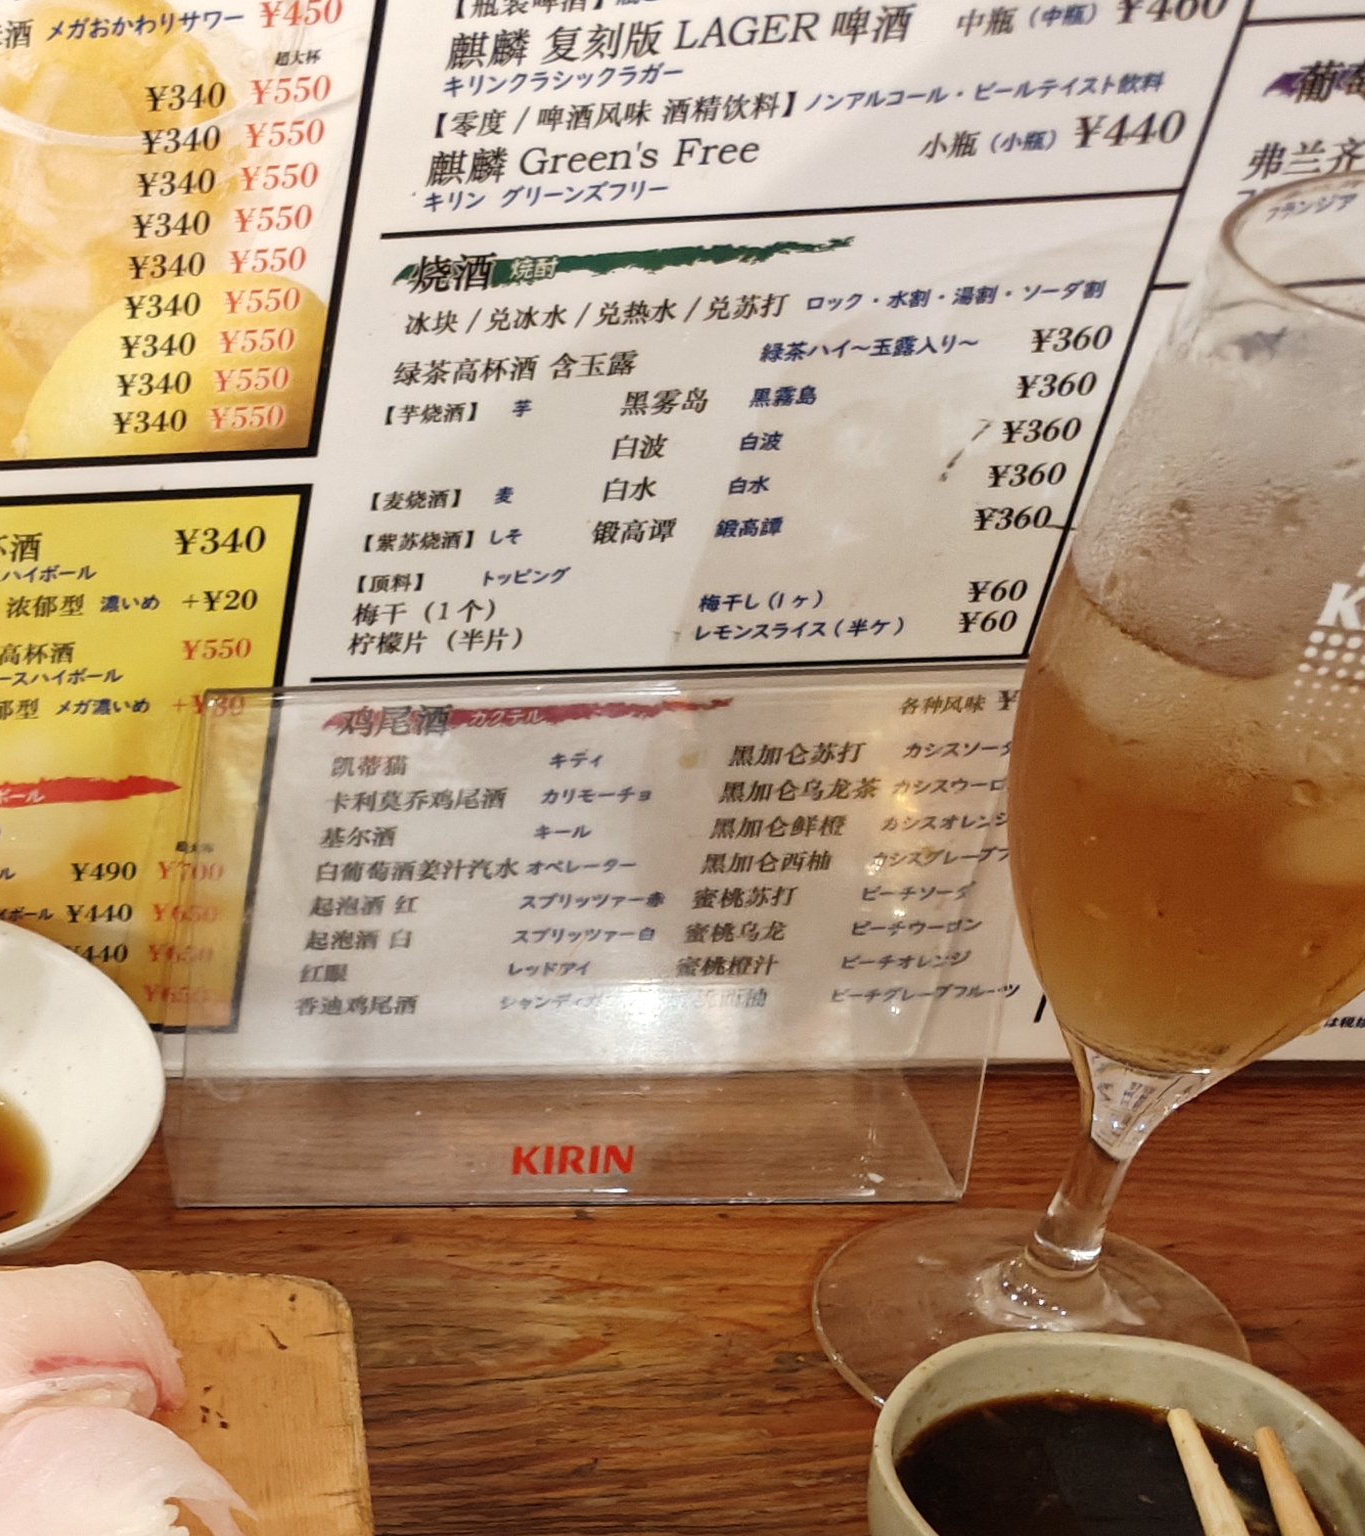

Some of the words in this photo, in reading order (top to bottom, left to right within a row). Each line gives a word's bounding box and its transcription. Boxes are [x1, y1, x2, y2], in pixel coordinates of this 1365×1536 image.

[46, 11, 245, 42] メガおかわりサワー
[673, 12, 821, 51] LAGER
[831, 3, 917, 45] 啤酒
[145, 82, 227, 112] ¥340
[250, 75, 332, 106] ¥550
[443, 63, 684, 98] キリンクラシックラガー
[141, 125, 222, 156] ¥340
[246, 118, 325, 149] ¥550
[519, 141, 659, 176] Green's
[672, 138, 761, 168] Free
[1074, 110, 1187, 150] ¥440
[136, 168, 216, 198] ¥340
[240, 162, 319, 191] ¥550
[423, 192, 486, 213] キリン
[501, 180, 670, 209] グリーンズフリー
[132, 210, 211, 239] ¥340
[234, 204, 313, 233] ¥550
[128, 252, 206, 280] ¥340
[229, 246, 307, 274] ¥550
[409, 252, 498, 295] 烧酒
[124, 292, 201, 319] ¥340
[224, 287, 301, 314] ¥550
[405, 309, 460, 336] 冰块
[484, 304, 568, 334] 兑冰水
[704, 292, 791, 322] 兑苏打
[120, 332, 196, 359] ¥340
[219, 327, 296, 354] ¥550
[392, 354, 540, 386] 绿茶高杯酒
[548, 349, 639, 381] 含玉露
[1030, 324, 1113, 353] ¥360
[117, 371, 192, 397] ¥340
[214, 366, 290, 393] ¥550
[1016, 371, 1098, 400] ¥360
[112, 409, 187, 435] ¥340
[210, 405, 285, 431] ¥550
[611, 433, 669, 460] 白波
[739, 431, 784, 452] 白波
[1001, 417, 1083, 445] ¥360
[602, 476, 658, 503] 白水
[728, 475, 770, 496] 白水
[987, 461, 1068, 489] ¥360
[173, 526, 267, 556] ¥340
[489, 528, 523, 546] しそ
[974, 505, 1053, 532] ¥360
[482, 566, 572, 588] トッピング
[968, 579, 1029, 605] ¥60
[6, 594, 85, 619] 浓郁型
[958, 610, 1019, 635] ¥60
[181, 637, 253, 661] ¥550
[341, 703, 453, 738] 鸡尾酒
[533, 824, 593, 840] キール
[70, 861, 137, 882] ¥490
[66, 903, 133, 924] ¥440
[512, 1145, 635, 1176] KIRIN
